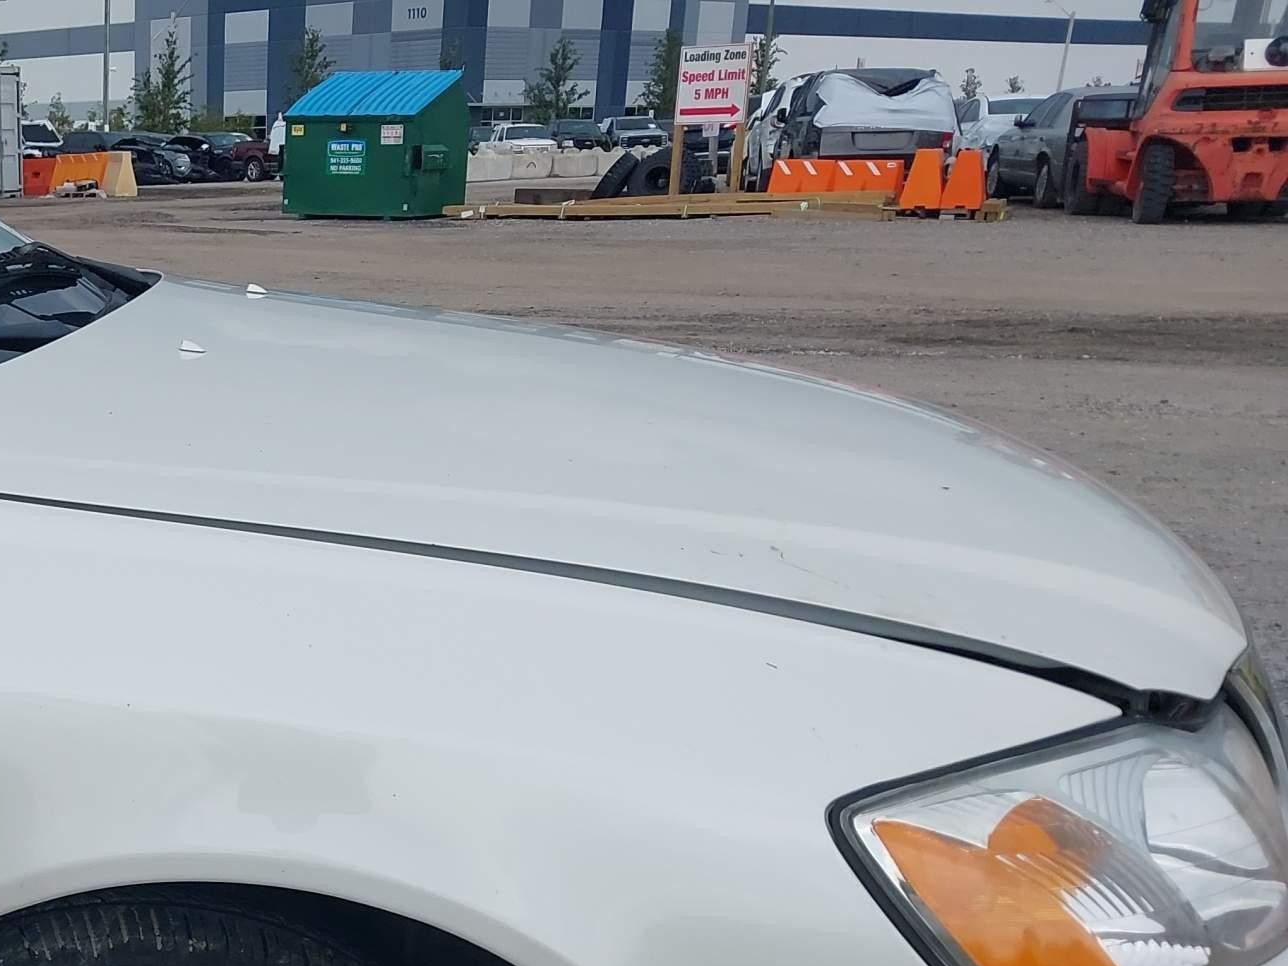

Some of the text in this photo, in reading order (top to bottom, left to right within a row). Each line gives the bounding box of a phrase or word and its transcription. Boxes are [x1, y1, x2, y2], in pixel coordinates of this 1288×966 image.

[408, 7, 427, 19] 1110
[684, 49, 747, 63] Loading Zone
[681, 68, 746, 84] Speed Limit
[694, 87, 729, 100] 5 MPH
[330, 143, 350, 151] WASTE
